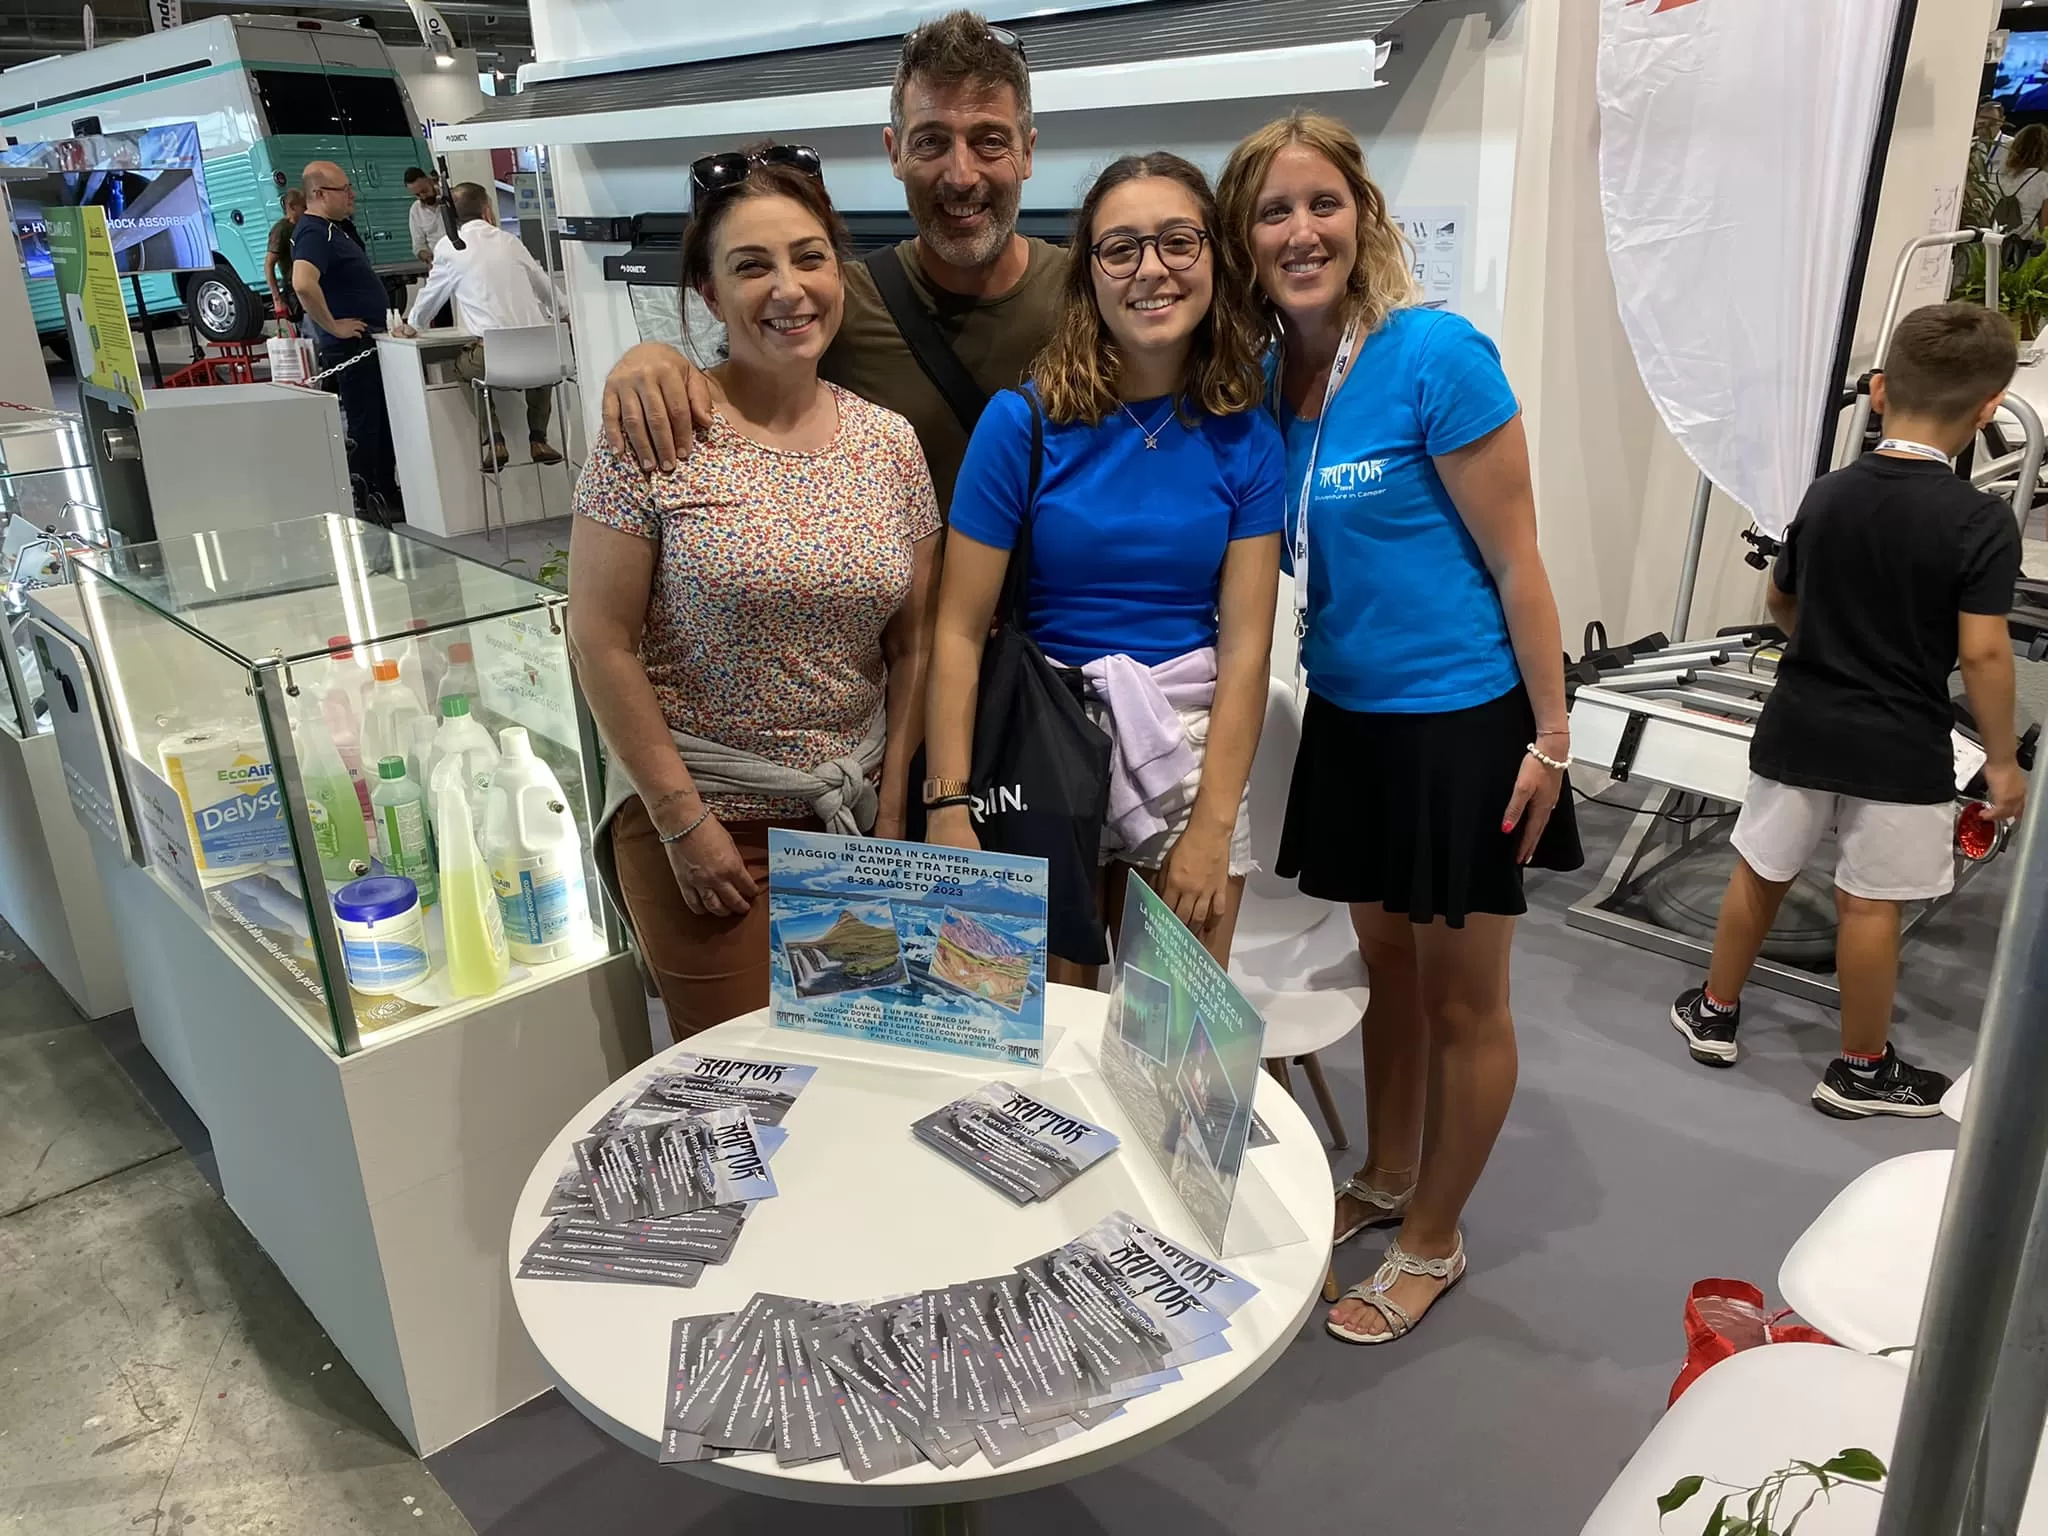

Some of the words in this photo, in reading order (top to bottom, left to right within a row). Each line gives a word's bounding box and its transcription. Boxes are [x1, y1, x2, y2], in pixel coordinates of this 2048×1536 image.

[626, 265, 647, 274] DOMETIC
[1318, 457, 1392, 489] RAPTOR
[1357, 488, 1388, 499] Camper
[783, 845, 836, 860] VIAGGIO
[840, 852, 853, 862] IN
[858, 854, 911, 868] CAMPER
[915, 861, 940, 872] TRA
[945, 865, 1033, 883] TERRA,CIELO
[843, 841, 900, 855] ISLANDA
[905, 849, 917, 858] IN
[921, 851, 968, 864] CAMPER
[846, 875, 873, 886] 8-26
[877, 878, 929, 893] AGOSTO
[932, 885, 963, 897] 2023
[853, 863, 898, 878] ACQUA
[903, 870, 911, 879] E
[915, 872, 960, 886] FUOCO
[522, 880, 536, 912] ecologico
[1139, 900, 1148, 918] LA
[1169, 935, 1181, 956] DEL
[1182, 951, 1209, 988] NATALE
[1216, 989, 1243, 1030] CACCIA
[1156, 907, 1188, 950] LAPPONIA
[1189, 944, 1197, 959] IN
[1197, 953, 1226, 993] CAMPER
[813, 1010, 834, 1019] COME
[841, 1015, 876, 1026] VULCANI
[895, 1023, 937, 1035] GHIACCIAI
[938, 1029, 986, 1042] CONVIVONO
[822, 1006, 849, 1015] LUOGO
[850, 1010, 870, 1018] DOVE
[872, 1013, 912, 1024] ELEMENTI
[914, 1019, 954, 1030] NATURALI
[955, 1025, 990, 1036] OPPOSTI
[839, 1001, 880, 1013] L'ISLANDA
[889, 1008, 901, 1016] UN
[903, 1010, 929, 1020] PAESE
[930, 1014, 953, 1023] UNICO
[1219, 1007, 1234, 1034] DAL
[806, 1016, 842, 1027] ARMONIA
[854, 1023, 887, 1033] CONFINI
[888, 1028, 903, 1036] DEL
[905, 1030, 940, 1041] CIRCOLO
[942, 1036, 975, 1047] POLARE
[975, 1041, 1006, 1051] ARTICO
[870, 1033, 893, 1041] PARTI
[894, 1036, 911, 1044] CON
[913, 1038, 928, 1046] NOI
[693, 1056, 795, 1085] RAPTOR
[1002, 1090, 1099, 1145] RAPTOR
[713, 1116, 769, 1182] RAPTOR
[1110, 1235, 1209, 1318] RAPTOR
[1075, 1252, 1119, 1296] Adventure
[1126, 1304, 1162, 1338] Camper
